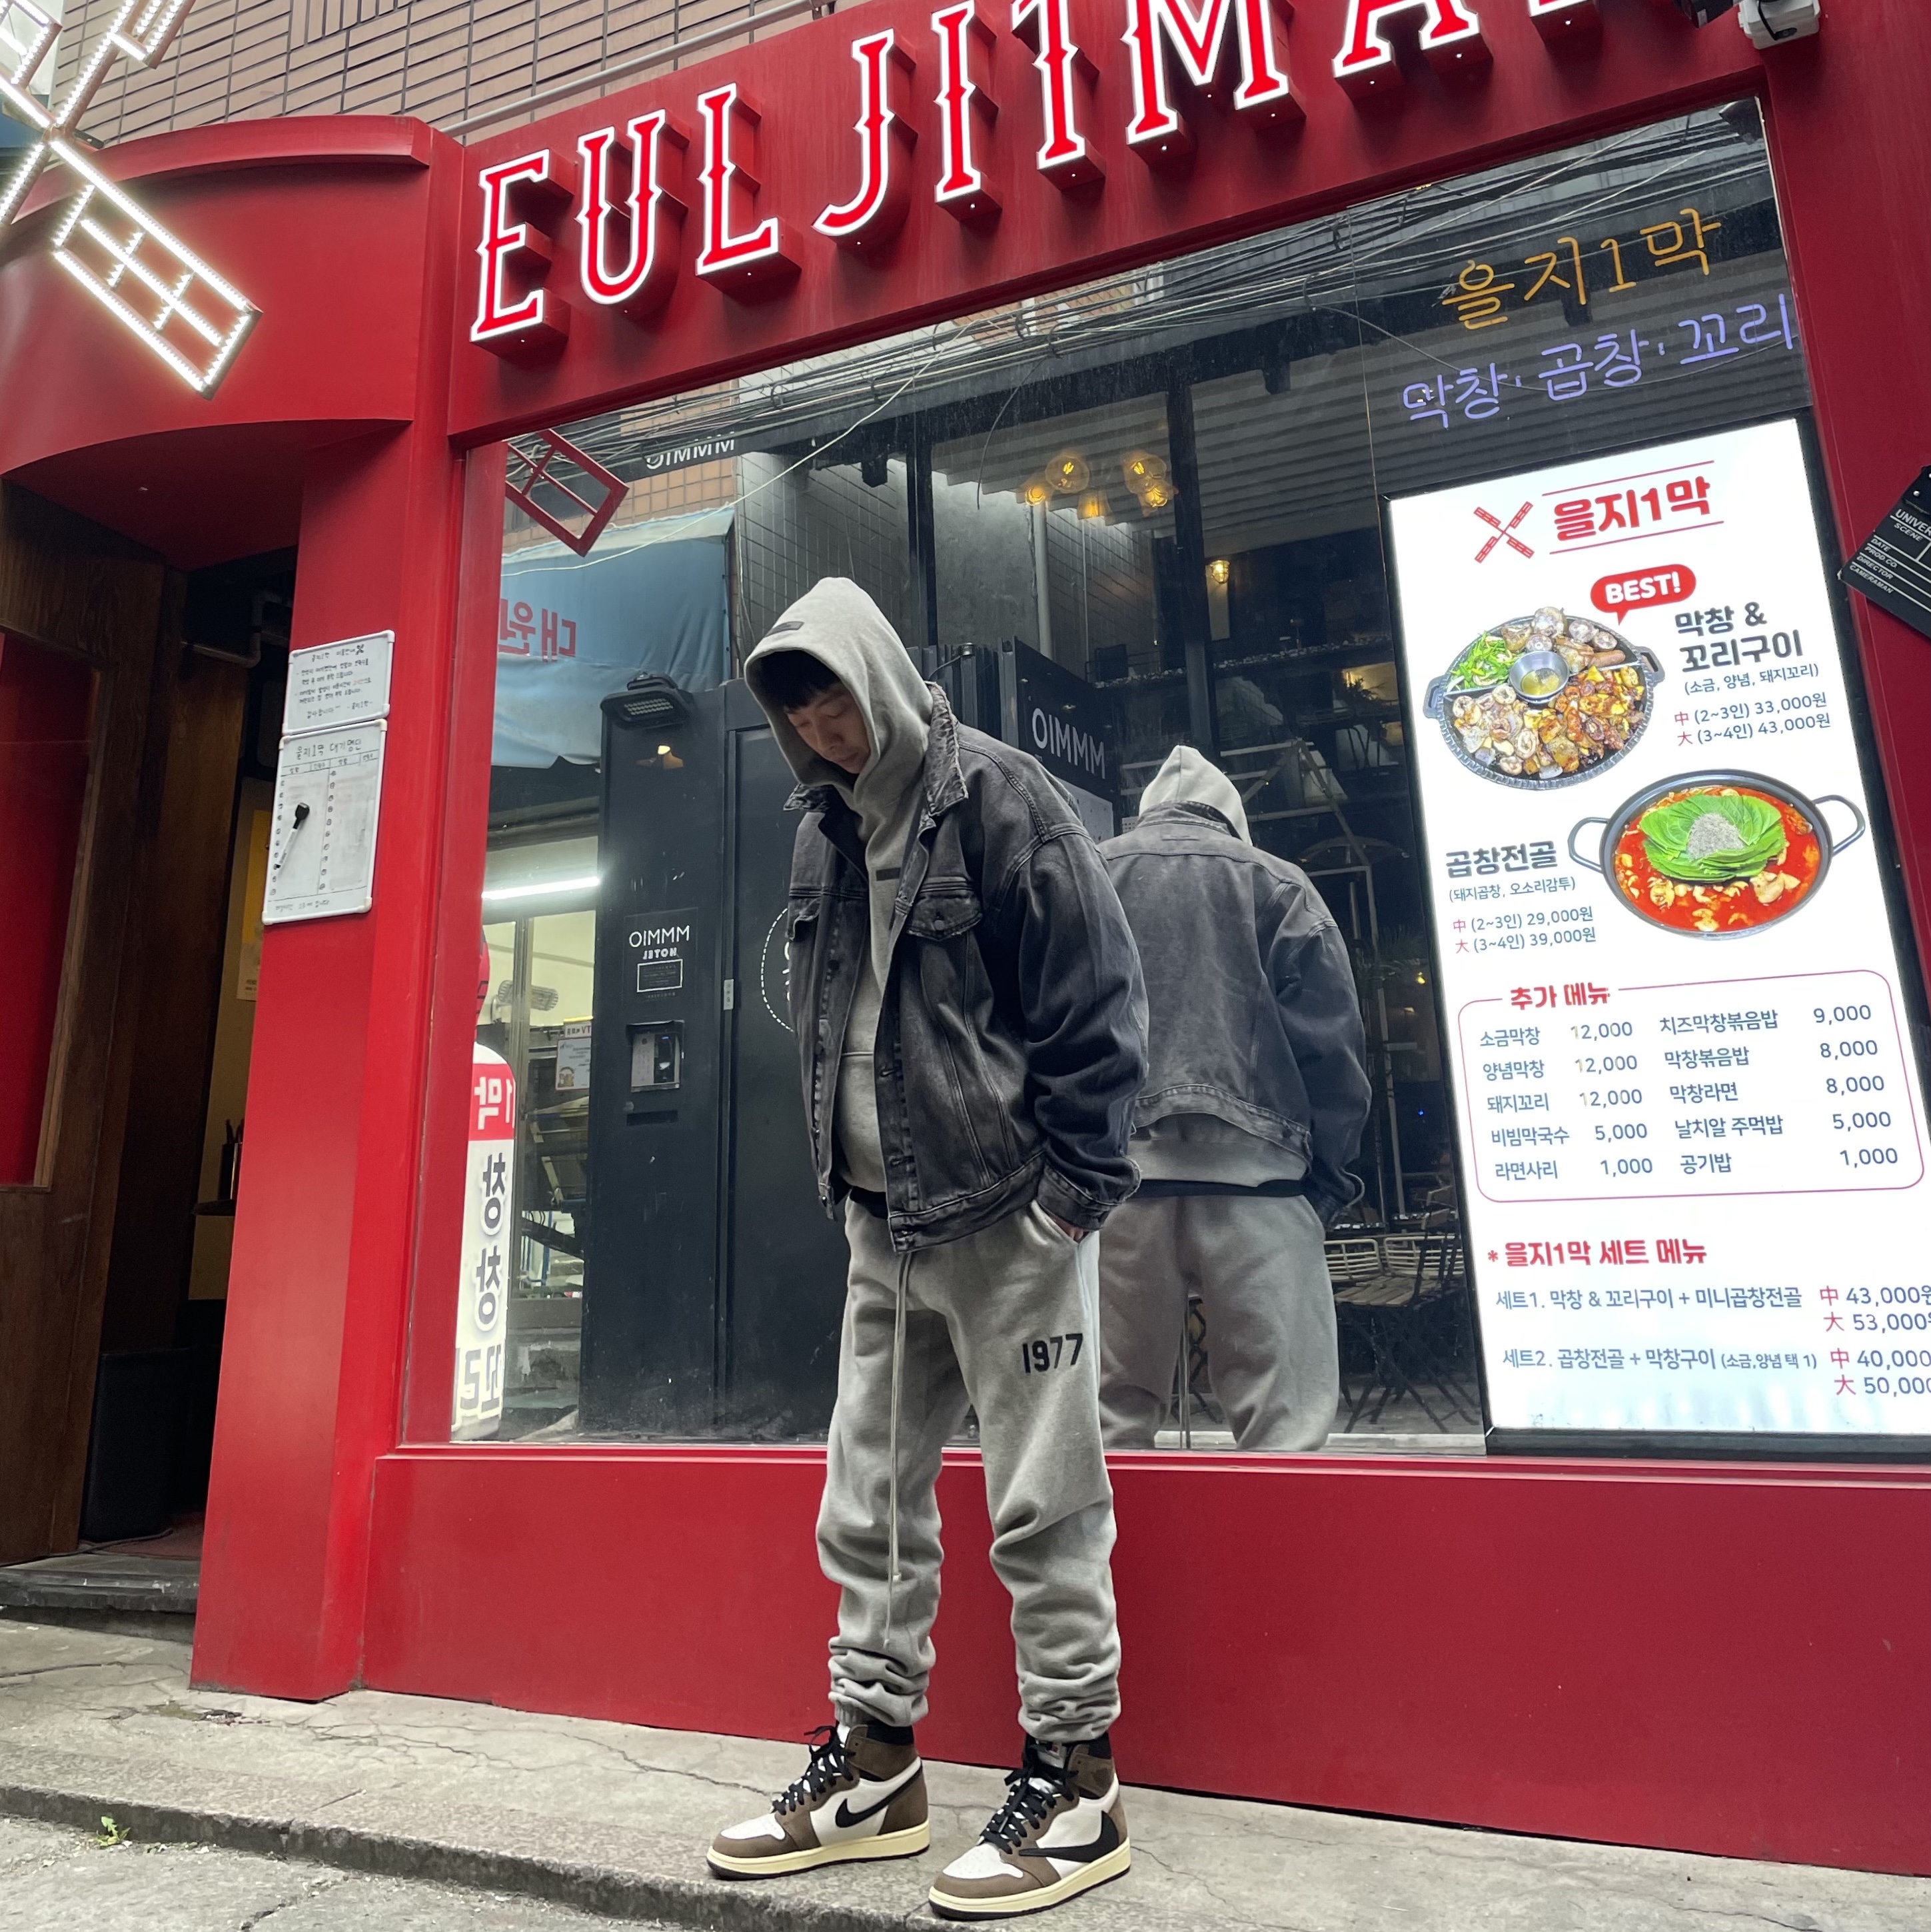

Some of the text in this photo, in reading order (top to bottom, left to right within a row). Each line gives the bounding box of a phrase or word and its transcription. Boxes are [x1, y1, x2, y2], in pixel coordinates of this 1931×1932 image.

[469, 0, 1589, 344] EULJI1M
[1442, 208, 1721, 329] 을지1막
[1553, 476, 1711, 541] 을지1막
[1870, 538, 1890, 552] DATE
[1894, 522, 1923, 542] SCENE
[1849, 565, 1894, 594] CAMERAMAN
[1856, 555, 1894, 580] DIRECTOR
[1605, 571, 1682, 604] BEST!
[1675, 602, 1767, 636] 막창 &
[1678, 628, 1808, 674] 꼬리구이
[1674, 692, 1826, 726] 中 (2~3인) 33,000원
[1678, 713, 1830, 746] 大 (3~4인) 43,000원
[1446, 841, 1557, 878] 곱창전골
[1453, 906, 1593, 932] 中 (2~3인) 29,000원
[1456, 927, 1596, 953] 大 (3~4인) 39,000원
[1511, 982, 1610, 1010] 추가 메뉴
[1660, 1005, 1871, 1035] 치즈막창볶음밥 9,000
[1481, 1022, 1632, 1047] 소금막창 12,000
[1664, 1040, 1878, 1069] 막창볶음밥 8,000
[1483, 1056, 1637, 1081] 양념막창 12,000
[1487, 1089, 1642, 1113] 돼지꼬리 12,000
[1670, 1076, 1884, 1104] 막창라면 8,000
[1491, 1124, 1647, 1147] 비빔막국수 5,000
[1675, 1112, 1891, 1139] 날치알 주먹밥 5,000
[1495, 1158, 1652, 1180] 라면사리 1,000
[1680, 1148, 1898, 1174] 공기밥 1,000
[1505, 1238, 1706, 1267] 을지1막 세트 메뉴
[1497, 1291, 1545, 1310] 세트1.
[1551, 1290, 1583, 1310] 막창
[1589, 1292, 1602, 1307] &
[1606, 1288, 1673, 1308] 꼬리구이
[1679, 1293, 1690, 1304] +
[1696, 1287, 1802, 1308] 미니곱창전골
[1820, 1286, 1838, 1306] 中
[1824, 1312, 1931, 1334] 大 53,000
[1022, 1333, 1083, 1374] 1977
[1503, 1349, 1552, 1368] 세트2.
[1558, 1349, 1624, 1369] 곱창전골
[1630, 1354, 1640, 1365] +
[1646, 1349, 1716, 1370] 막창구이
[1830, 1348, 1849, 1369] 中
[1857, 1350, 1931, 1370] 40,000
[1834, 1374, 1856, 1395] 大
